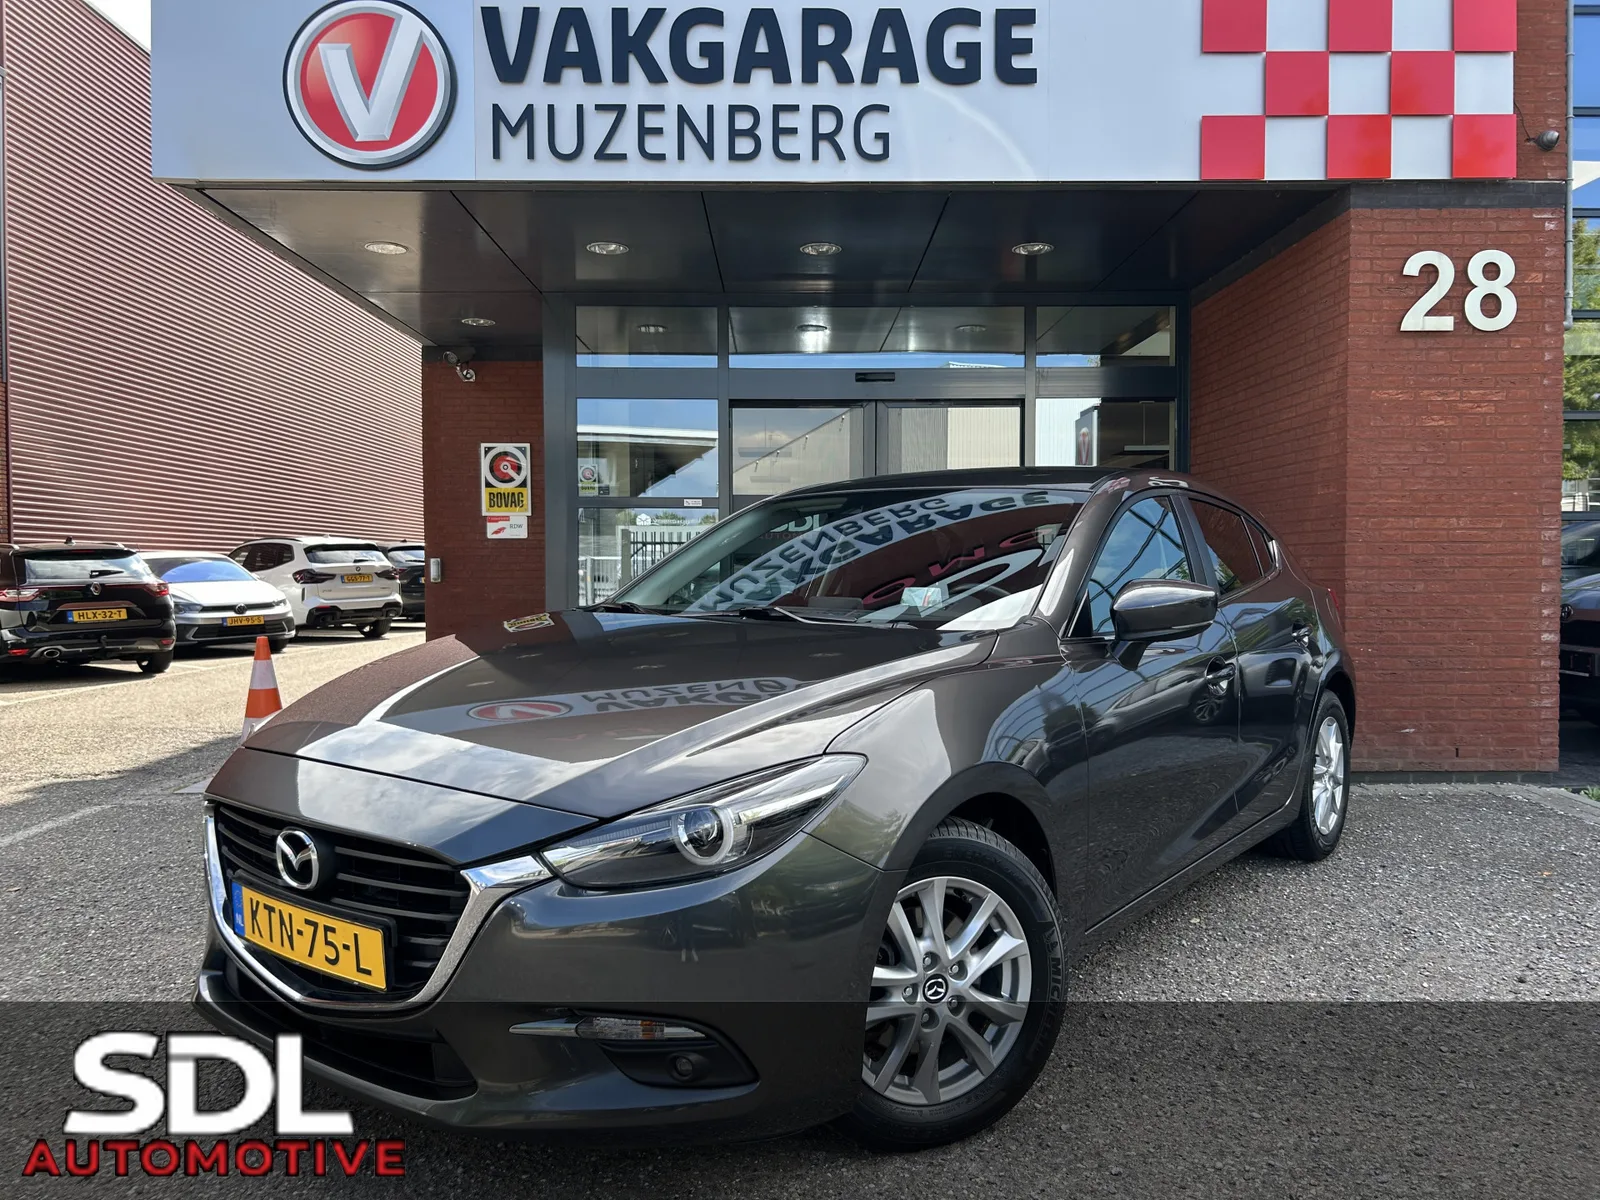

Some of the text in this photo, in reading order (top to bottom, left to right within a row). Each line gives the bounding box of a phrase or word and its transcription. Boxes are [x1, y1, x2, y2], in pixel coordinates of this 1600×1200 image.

[480, 7, 1037, 85] VAKGARAGE
[318, 13, 424, 142] V
[492, 103, 890, 162] MUZENBERG
[1400, 249, 1518, 332] 28
[488, 491, 524, 509] BOVAG
[77, 610, 123, 620] HLX-32-T
[229, 617, 262, 625] JHV-95-S
[235, 913, 244, 927] NL
[249, 897, 373, 977] KTN-75-L
